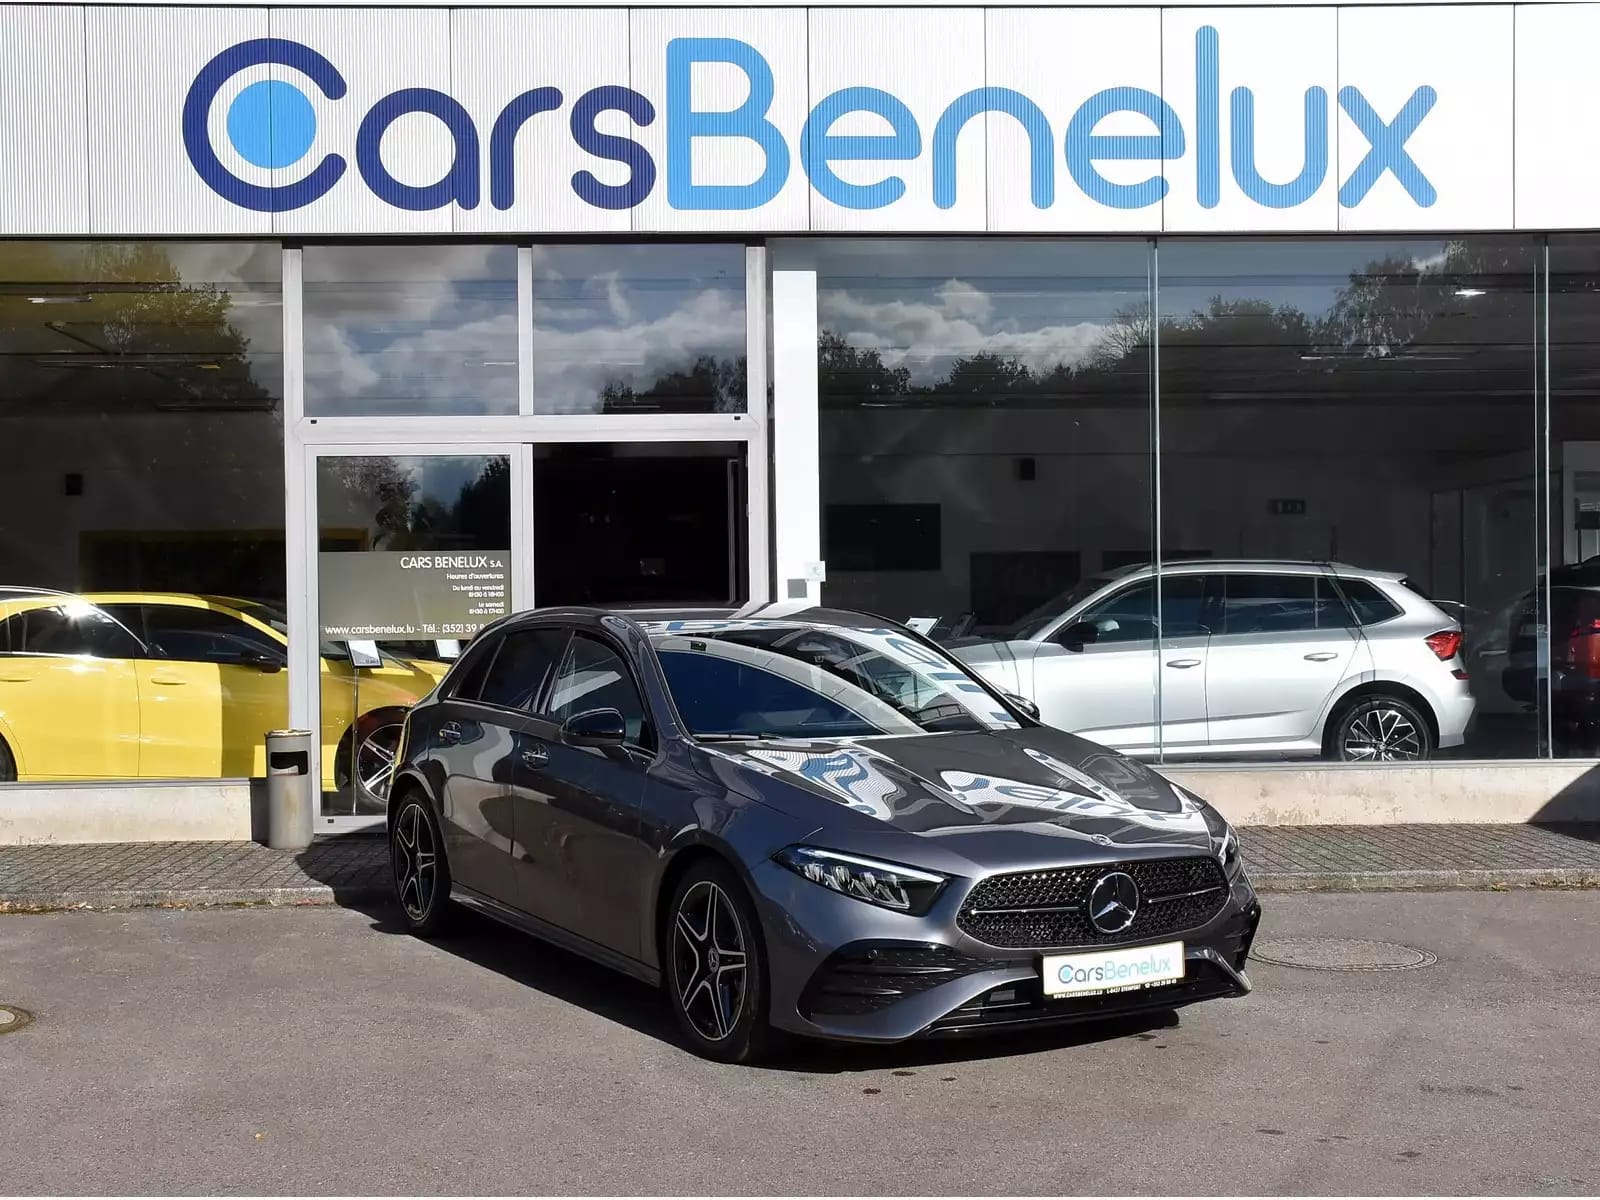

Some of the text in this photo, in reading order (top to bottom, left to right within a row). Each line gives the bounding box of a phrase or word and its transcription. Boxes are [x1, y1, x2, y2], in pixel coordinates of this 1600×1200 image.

[183, 25, 1437, 212] CarsBenelux
[400, 556, 504, 569] CARS BENELUX S.A.
[469, 572, 504, 580] d'ouvertures
[325, 623, 415, 635] www.carsbenelux.lu
[442, 623, 464, 634] (352)
[465, 624, 477, 633] 39
[1058, 955, 1171, 984] CarsBenelux
